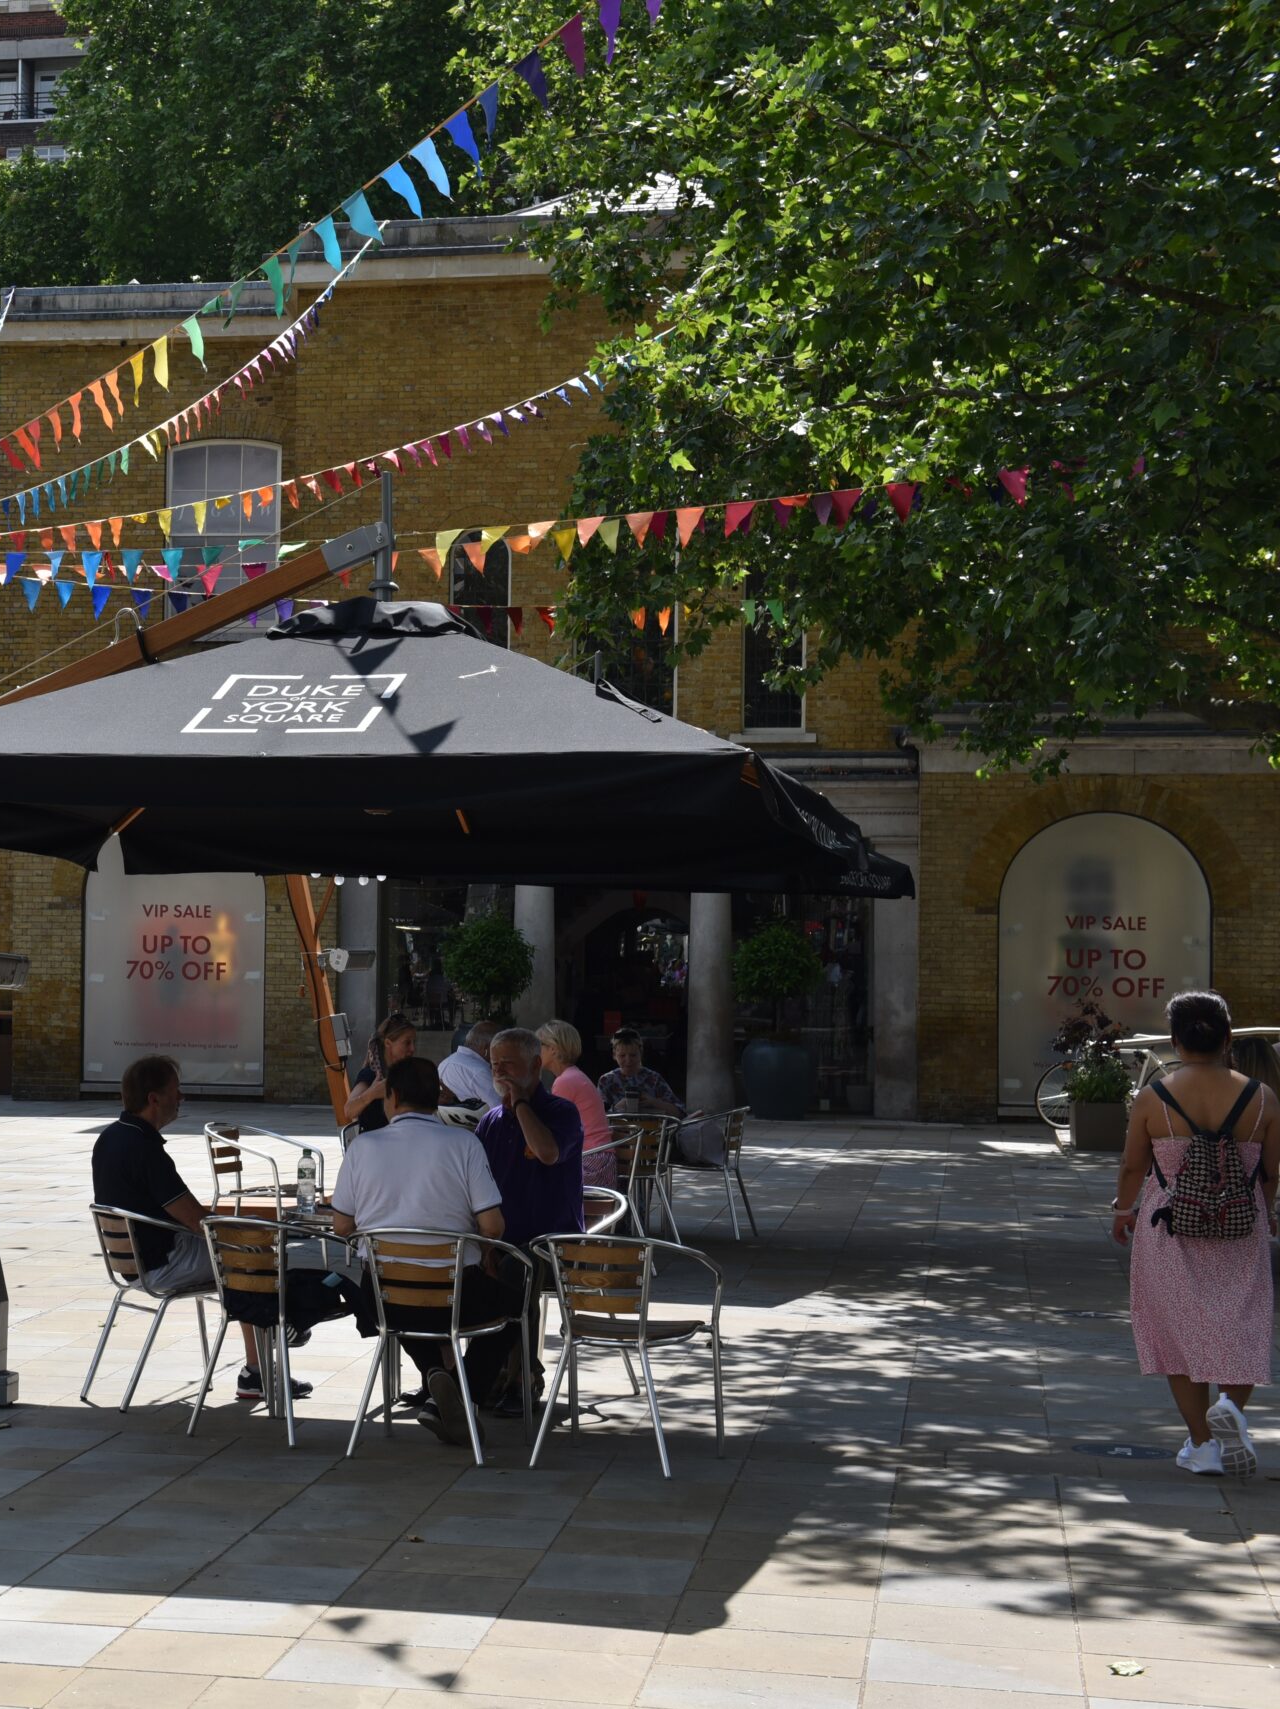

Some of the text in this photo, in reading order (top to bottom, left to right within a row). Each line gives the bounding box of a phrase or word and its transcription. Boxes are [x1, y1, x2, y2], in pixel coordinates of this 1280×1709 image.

[178, 505, 273, 520] JGSW
[247, 685, 365, 696] DUKE
[241, 701, 351, 713] YORK
[224, 713, 343, 724] SQUARE
[142, 904, 212, 918] VIP SALE
[1065, 915, 1147, 931] VIP SALE
[142, 935, 211, 955] UP TO
[1065, 948, 1147, 970] UP TO
[126, 961, 227, 981] 70% OFF
[1047, 976, 1165, 998] 70% OFF
